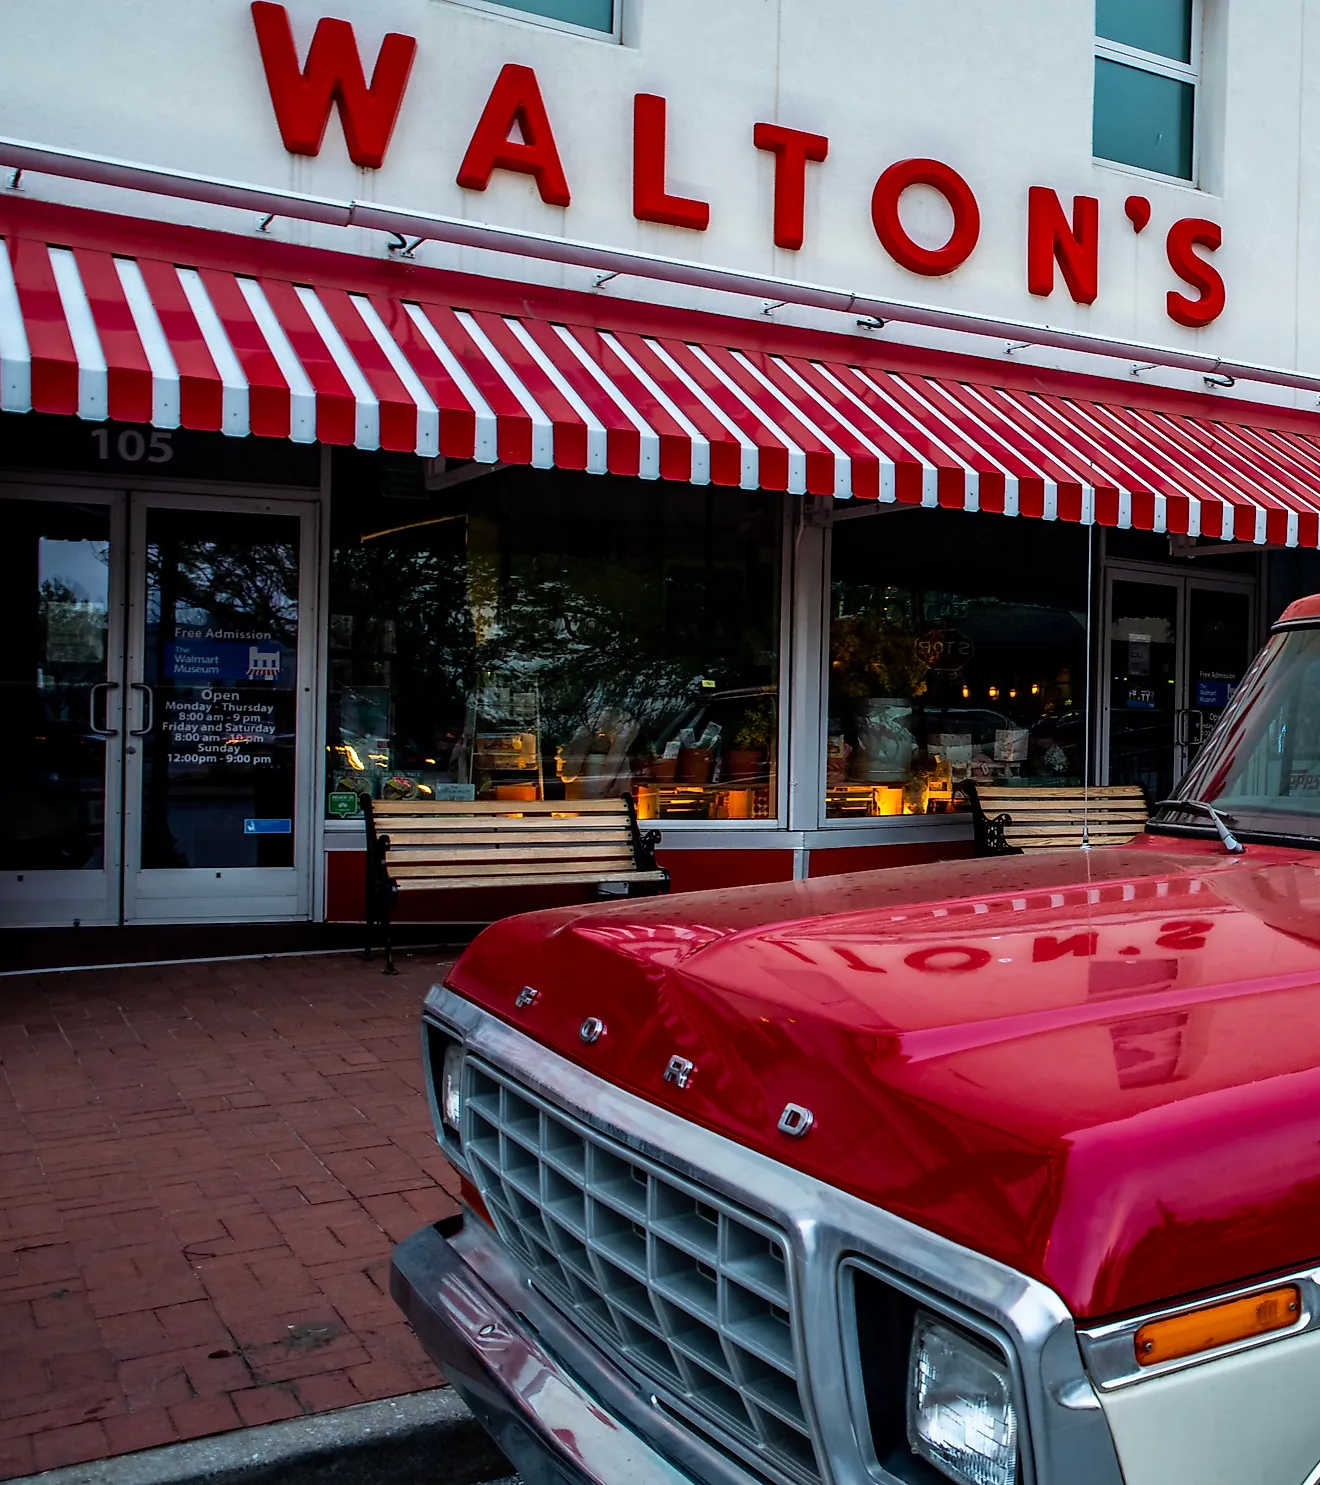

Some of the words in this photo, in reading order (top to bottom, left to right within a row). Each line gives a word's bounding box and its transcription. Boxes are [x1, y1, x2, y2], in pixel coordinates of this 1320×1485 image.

[251, 0, 1226, 329] WALTON'S
[91, 428, 174, 463] 105
[174, 628, 202, 638] Free
[205, 628, 272, 640] Admission
[174, 654, 219, 664] Walmart
[173, 664, 219, 674] Museum
[201, 689, 240, 702] Open
[165, 701, 213, 712] Monday
[221, 703, 274, 714] Thursday
[178, 712, 204, 721] 8:00
[206, 713, 224, 721] am
[232, 713, 240, 722] 9
[242, 714, 261, 725] pm
[162, 721, 199, 733] Friday
[200, 722, 223, 732] and
[225, 723, 276, 735] Saturday
[174, 732, 200, 742] 8:00
[201, 734, 220, 742] am
[246, 735, 264, 745] pm
[197, 743, 241, 755] Sunday
[167, 754, 217, 765] 12:00pm
[225, 754, 251, 763] 9:00
[253, 755, 272, 766] pm
[515, 986, 814, 1138] FORD
